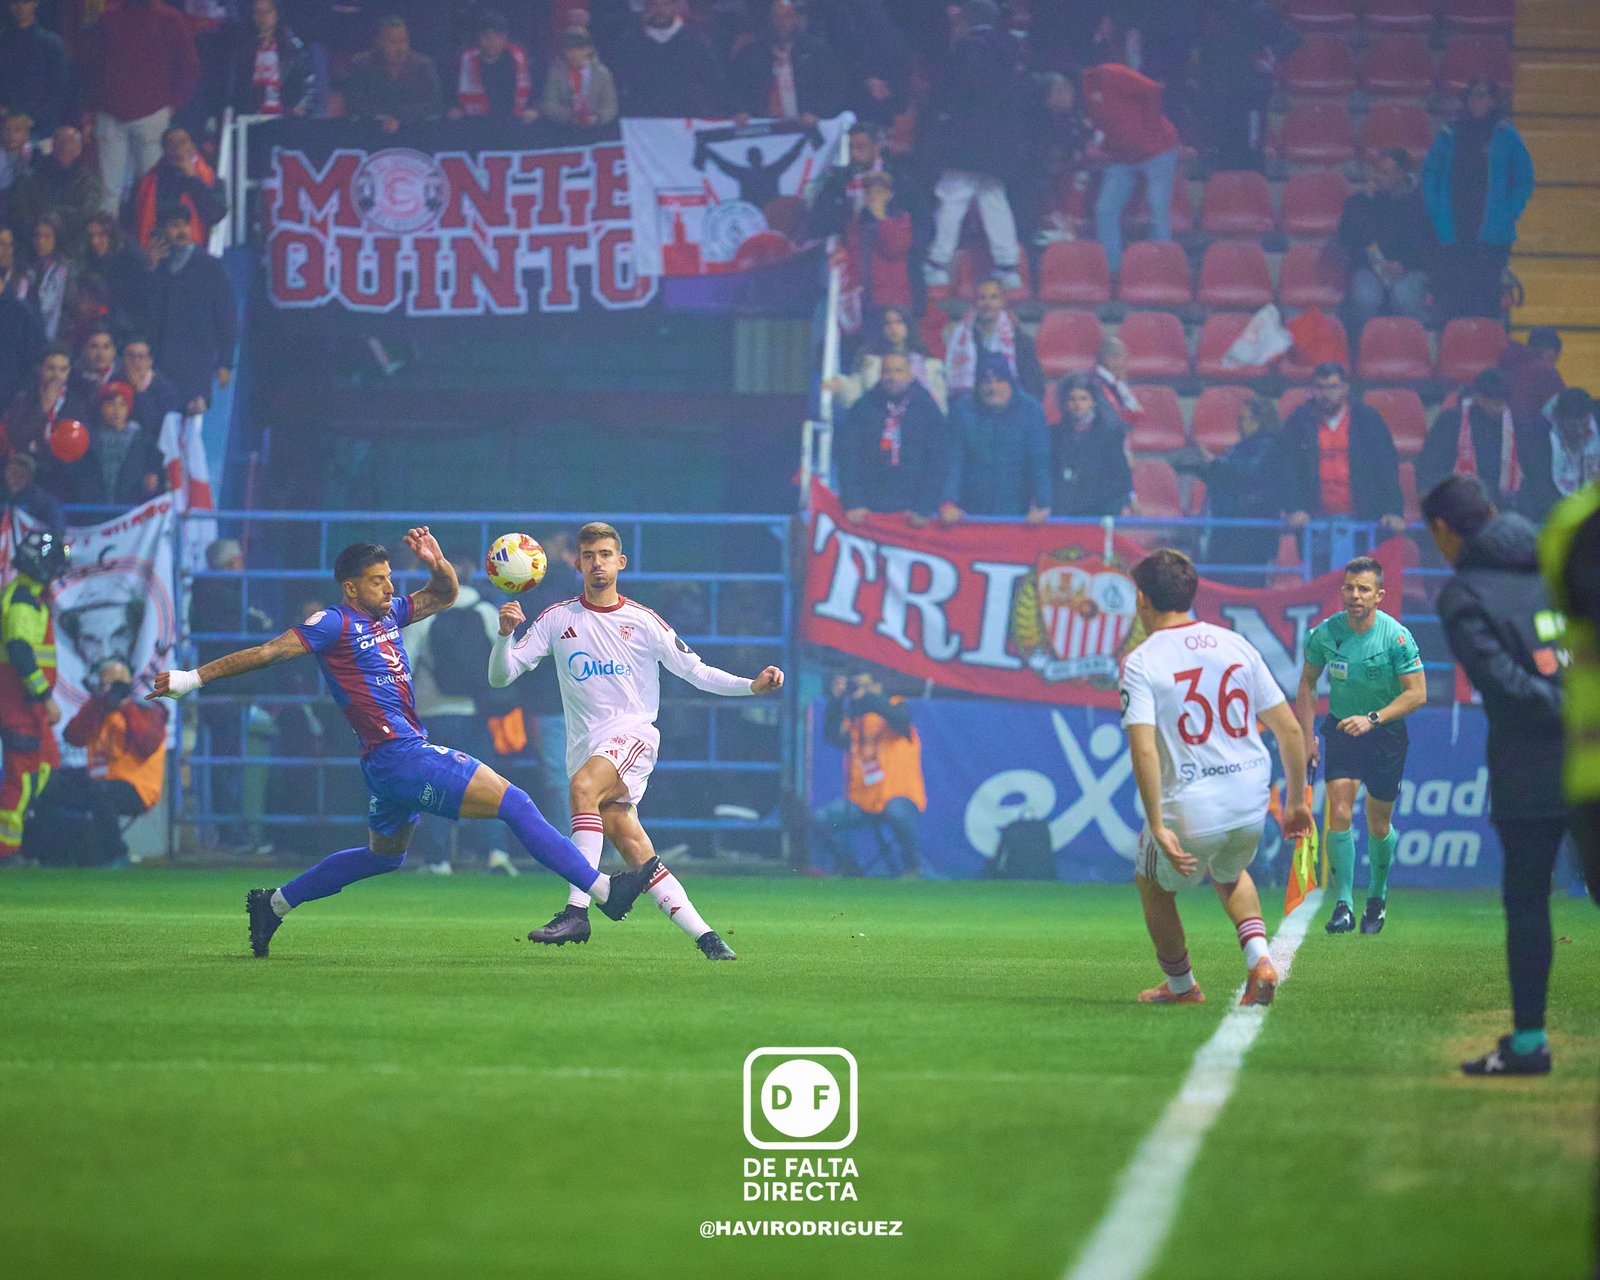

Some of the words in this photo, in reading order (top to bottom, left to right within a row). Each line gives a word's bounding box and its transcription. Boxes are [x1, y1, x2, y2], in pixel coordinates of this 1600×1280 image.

[268, 228, 658, 316] QUINTO
[570, 654, 630, 681] Midea
[1173, 663, 1249, 745] 36
